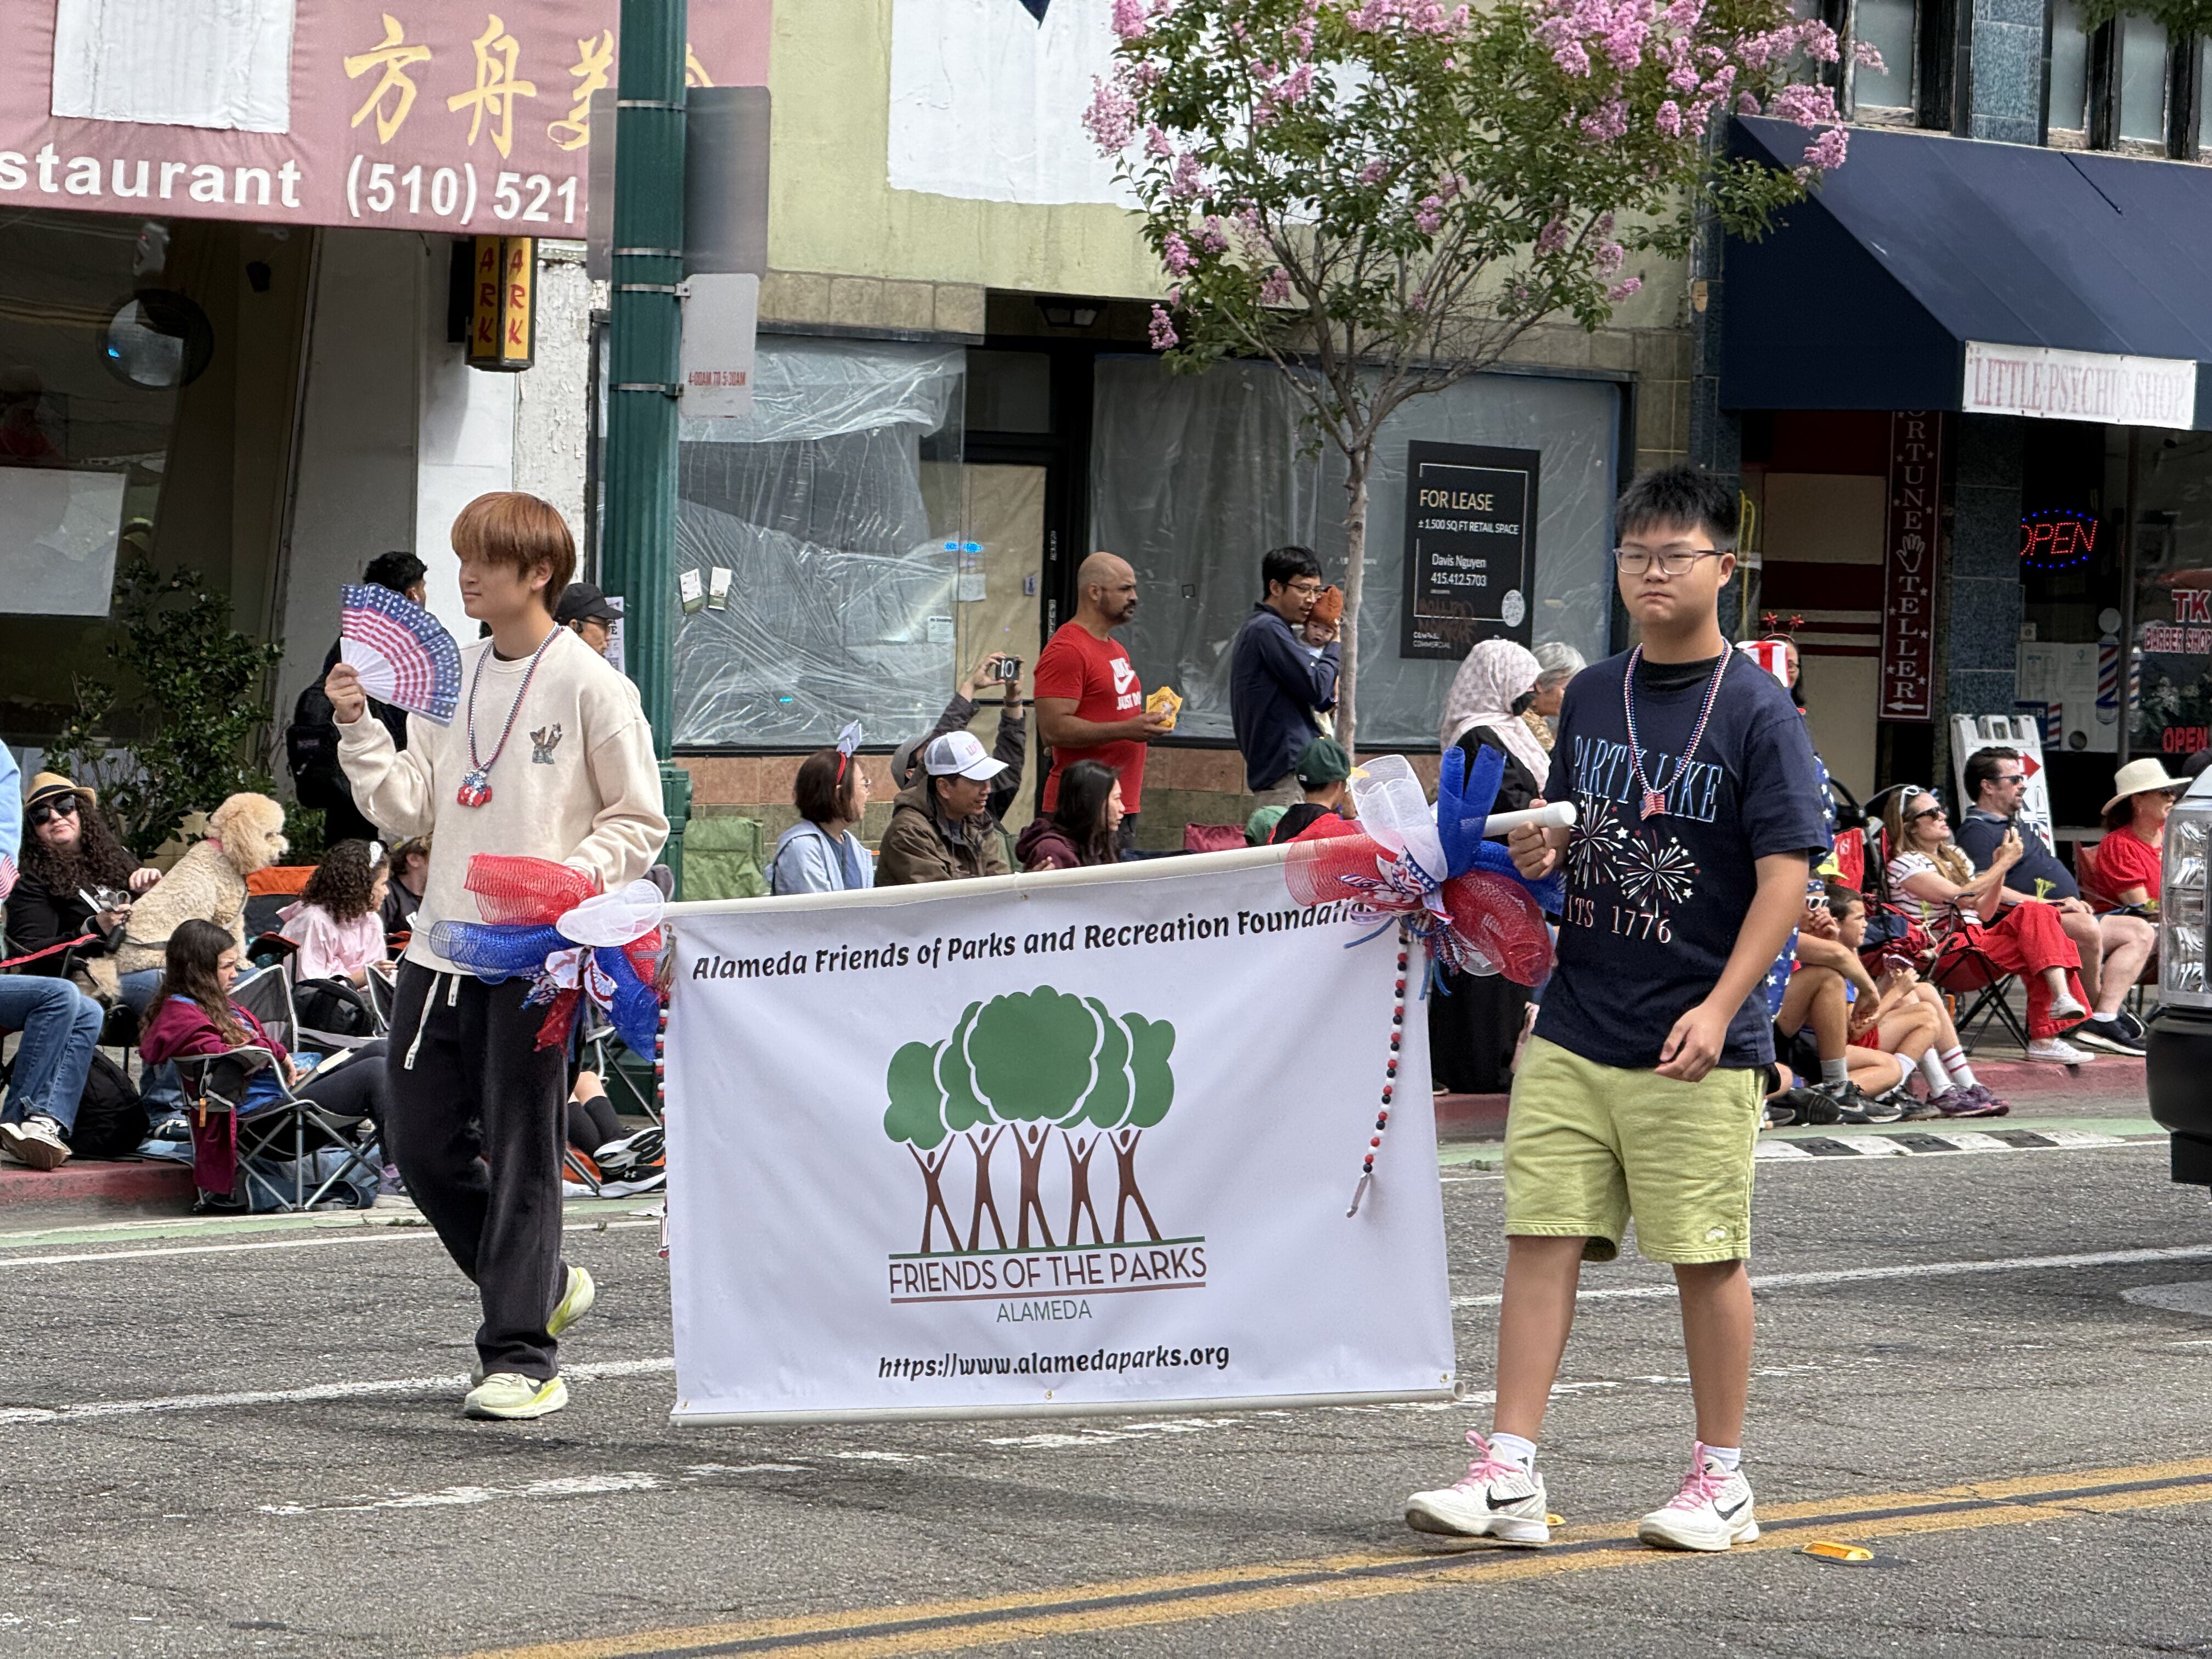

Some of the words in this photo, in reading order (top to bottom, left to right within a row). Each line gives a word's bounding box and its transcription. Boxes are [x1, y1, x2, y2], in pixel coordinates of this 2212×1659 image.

[0, 143, 301, 207] staurant
[347, 154, 477, 225] (510)
[494, 172, 588, 224] 521
[479, 246, 496, 343] ARK
[509, 249, 525, 345] ARK
[1974, 358, 2042, 410] LITTLE
[2047, 363, 2129, 415] PSYCHIC
[2133, 370, 2186, 421] SHOP
[1419, 489, 1449, 509] FOR
[1452, 491, 1493, 511] LEASE
[1447, 520, 1458, 532] SQ
[1459, 521, 1469, 531] FT
[1469, 522, 1494, 533] RETAIL
[1495, 523, 1520, 535] SPACE
[1431, 553, 1454, 566] Davis
[1455, 555, 1487, 569] Nguyen
[2171, 589, 2211, 623] TK
[1893, 575, 1921, 699] TELLER
[2144, 627, 2183, 653] BARBER
[2163, 726, 2208, 753] OPEN
[1572, 735, 1647, 804] PARTY
[692, 950, 807, 980] Alameda
[815, 943, 910, 973] Friends
[917, 937, 942, 968] of
[948, 932, 1017, 962] Parks
[1024, 925, 1076, 954] and
[1085, 913, 1229, 950] Recreation
[1237, 900, 1373, 935] Foundatio
[1567, 894, 1594, 928] ITS
[1611, 905, 1672, 944] 1776
[889, 1260, 997, 1294] FRIENDS
[1003, 1257, 1041, 1288] OF
[1046, 1254, 1104, 1286] THE
[1110, 1246, 1207, 1283] PARKS
[996, 1299, 1092, 1323] ALAMEDA
[878, 1345, 1230, 1381] https://www.alamedaparks.org
